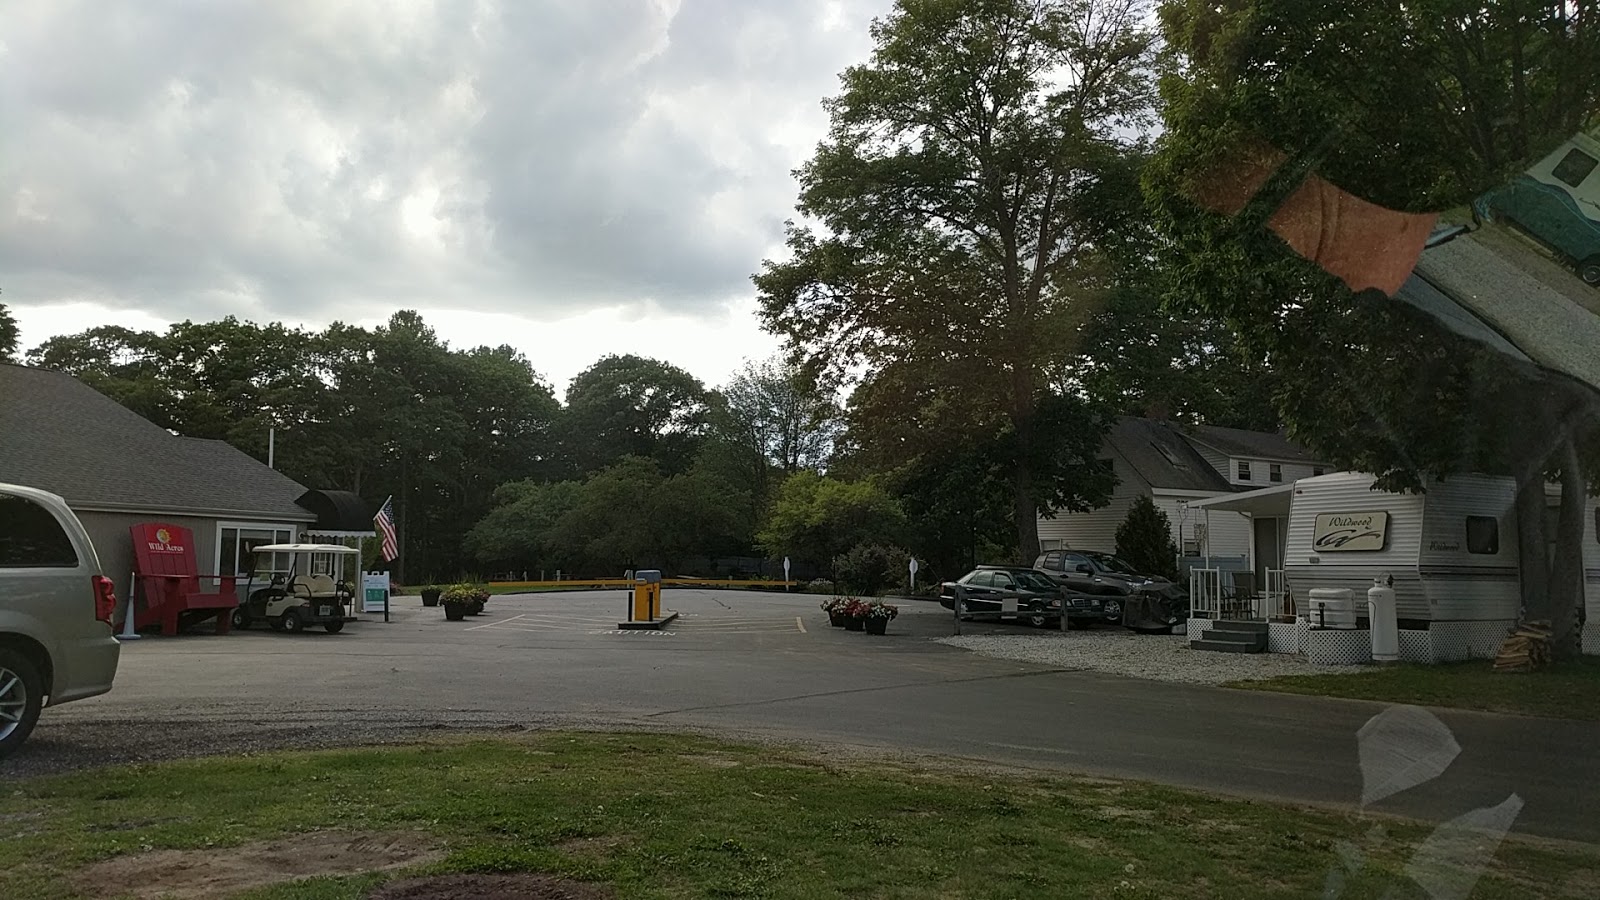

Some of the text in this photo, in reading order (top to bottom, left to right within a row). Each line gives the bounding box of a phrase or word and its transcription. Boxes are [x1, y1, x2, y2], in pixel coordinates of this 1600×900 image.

[1328, 516, 1373, 527] Wildwood
[148, 542, 165, 551] Wild
[166, 543, 184, 552] Acres
